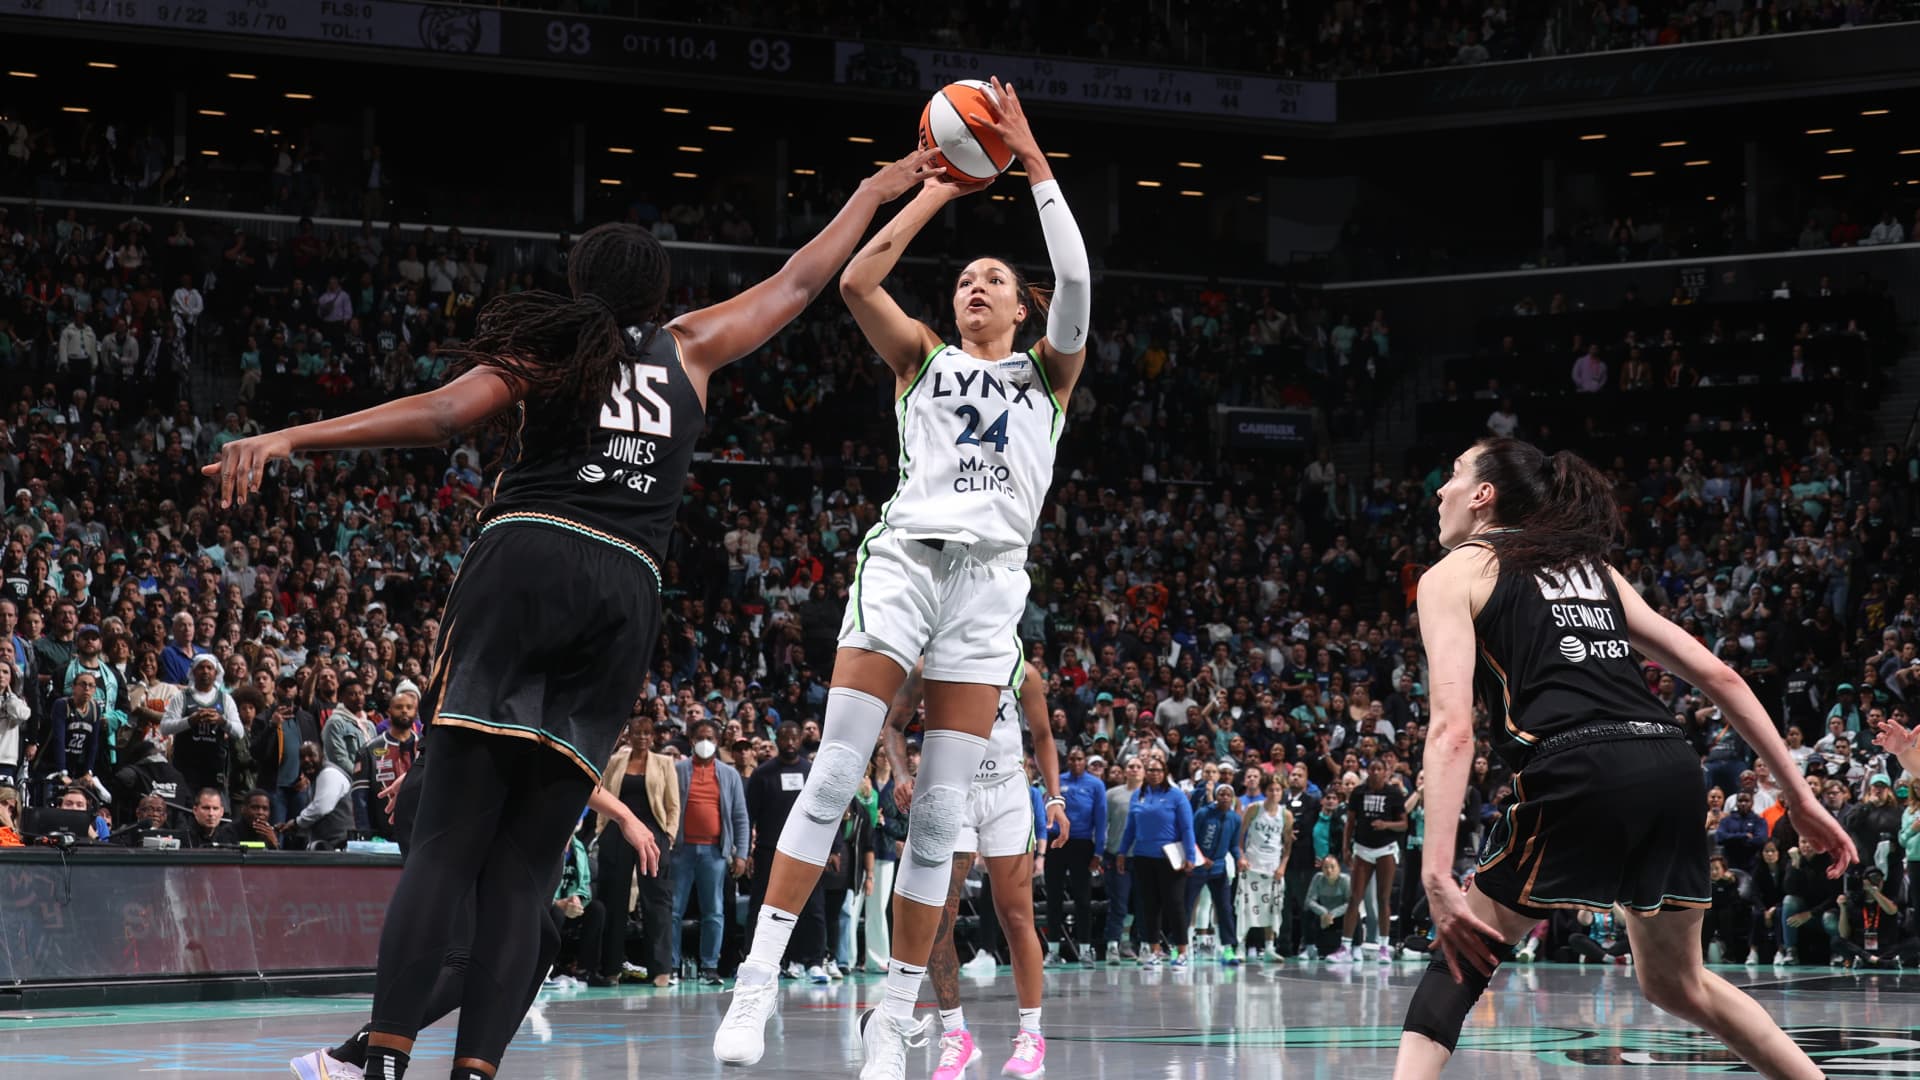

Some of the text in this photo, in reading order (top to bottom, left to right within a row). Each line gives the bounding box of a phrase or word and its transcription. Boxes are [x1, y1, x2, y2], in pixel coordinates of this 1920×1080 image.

[545, 20, 591, 55] 93
[623, 34, 718, 61] OT1 10.4
[748, 37, 793, 72] 93
[1279, 98, 1297, 114] 21
[932, 369, 1034, 410] LYNX
[954, 404, 1009, 453] 24
[603, 433, 656, 466] JONES
[1551, 603, 1616, 631] STEWART
[1589, 639, 1630, 659] AT&T
[68, 732, 86, 749] 22
[1203, 823, 1217, 849] LYNX
